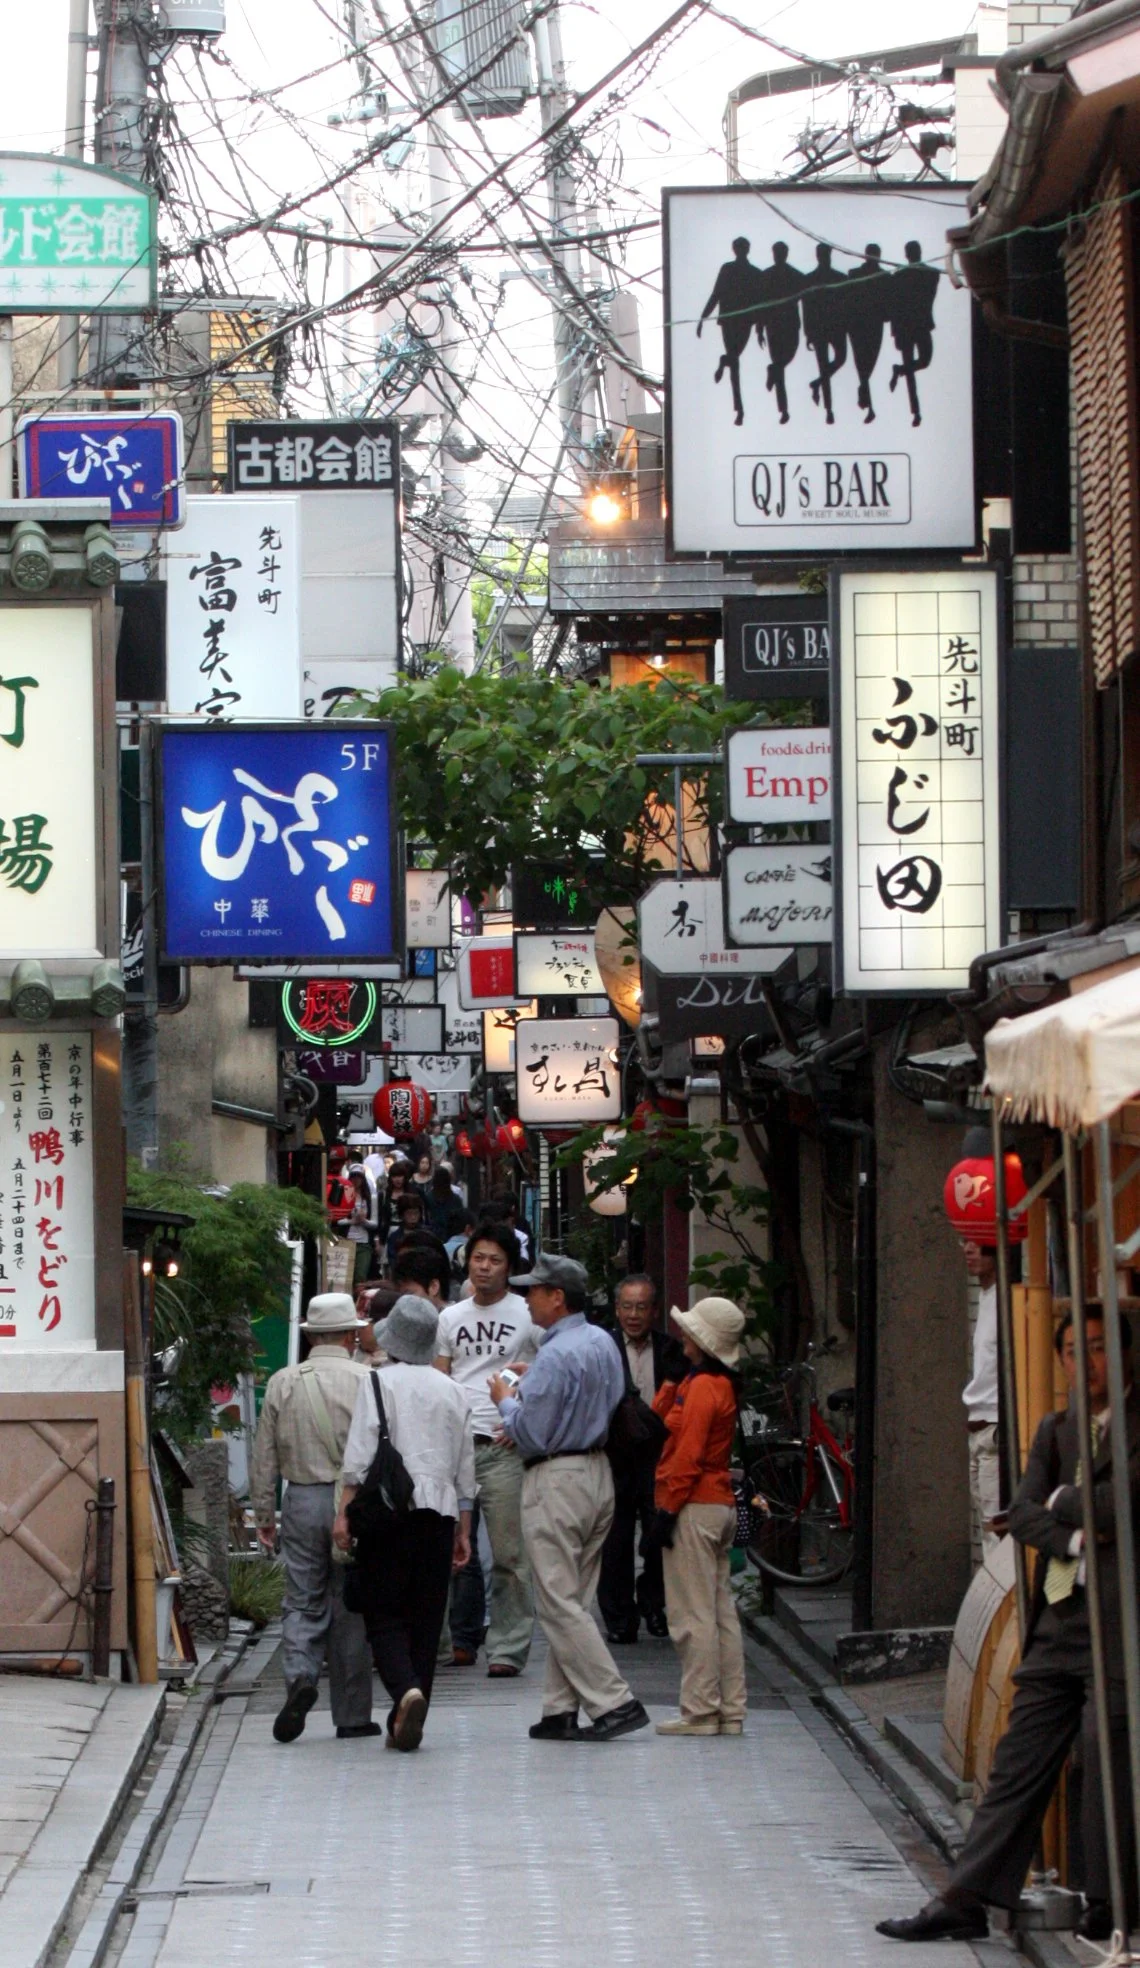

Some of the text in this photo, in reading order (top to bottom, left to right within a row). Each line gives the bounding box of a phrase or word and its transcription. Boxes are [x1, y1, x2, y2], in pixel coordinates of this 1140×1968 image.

[236, 435, 393, 484] 古都会館
[823, 460, 891, 508] BAR
[801, 509, 891, 518] SWEET SOUL MUSIC
[257, 525, 282, 615] 先斗町
[804, 626, 830, 660] BA
[942, 635, 979, 757] 先斗町
[340, 743, 379, 772] 5F
[744, 765, 830, 805] Emp
[872, 676, 943, 914] ふじ田
[200, 928, 284, 938] CHINESE DINING
[9, 1049, 25, 1133] 五月一日より
[68, 1043, 85, 1147] 京の年中行事
[11, 1157, 26, 1270] 五月二十四日まで
[28, 1126, 68, 1332] 鴨川をどり
[456, 1321, 516, 1346] ANF
